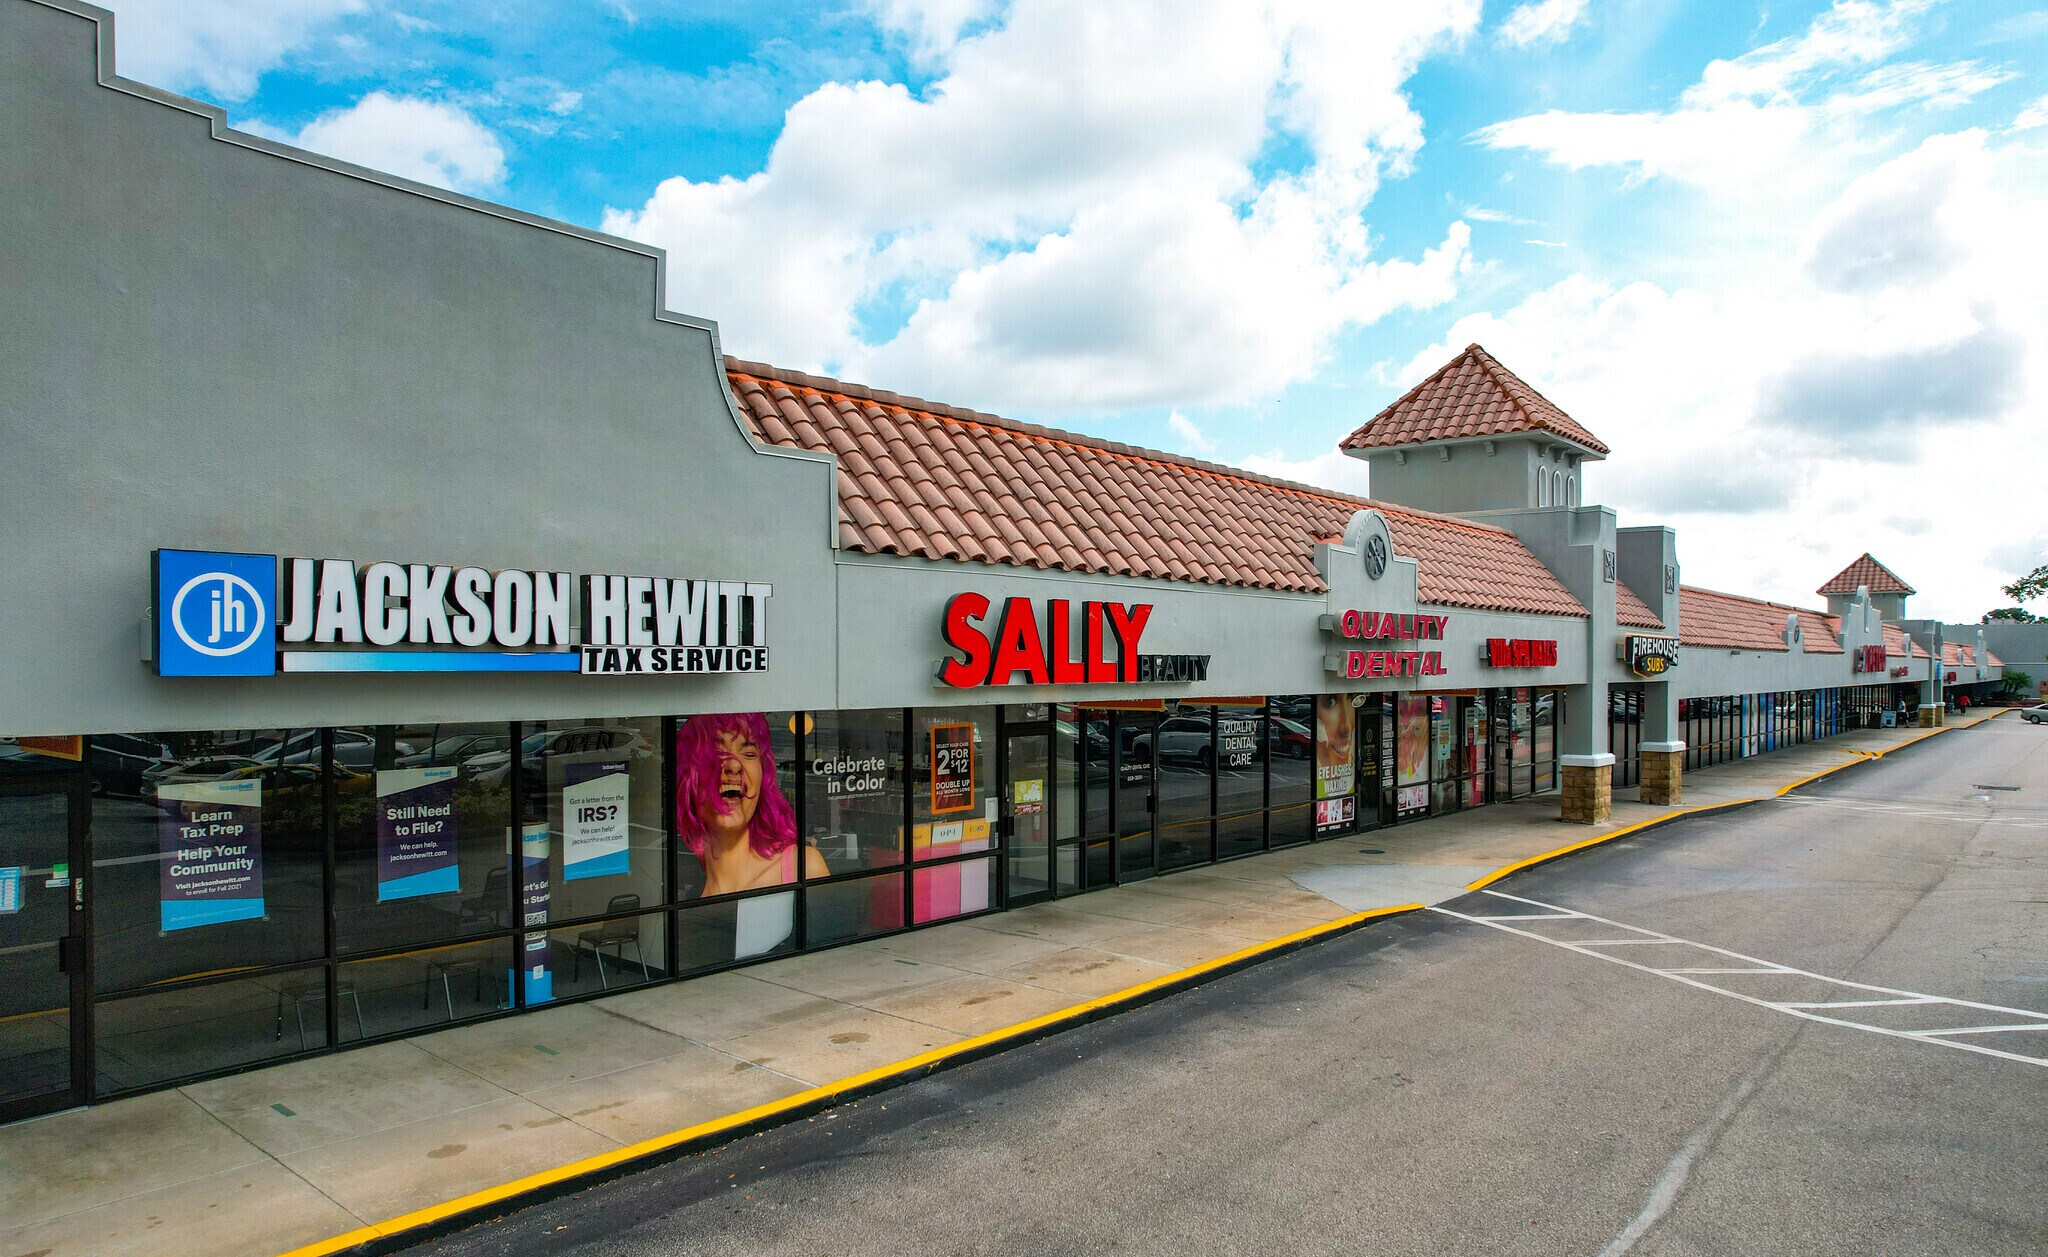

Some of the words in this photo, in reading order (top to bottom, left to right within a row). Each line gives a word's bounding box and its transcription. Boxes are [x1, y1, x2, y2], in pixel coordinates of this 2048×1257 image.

[283, 557, 571, 647] JACKSON
[587, 574, 773, 647] HEWITT
[1341, 609, 1449, 640] QUALITY
[938, 592, 1153, 688] SALLY
[1632, 636, 1679, 665] FIREHOUSE
[585, 647, 642, 672] TAX
[651, 647, 767, 672] SERVICE
[1347, 651, 1447, 678] DENTAL
[1647, 657, 1664, 672] SUBS
[1137, 655, 1211, 682] BEAUTY
[1224, 720, 1258, 734] QUALITY
[1225, 737, 1256, 750] DENTAL
[812, 755, 886, 775] Celebrate
[937, 749, 951, 775] 2
[951, 748, 969, 759] FOR
[1230, 753, 1252, 766] CARE
[1318, 766, 1330, 780] EYE
[827, 777, 841, 794] in
[845, 773, 885, 792] Color
[935, 780, 961, 790] DOUBLE
[961, 779, 971, 788] UP
[569, 797, 581, 805] Got
[585, 796, 600, 804] letter
[602, 795, 614, 803] from
[191, 810, 233, 823] Learn
[386, 806, 415, 820] Still
[417, 803, 451, 818] Need
[578, 805, 618, 823] IRS?
[180, 826, 207, 839] Tax
[209, 824, 244, 836] Prep
[395, 825, 410, 836] to
[412, 821, 444, 835] File?
[580, 827, 590, 835] We
[571, 834, 624, 847] jacksonhewitt.com
[178, 847, 212, 861] Help
[214, 844, 248, 857] Your
[390, 850, 448, 863] jacksonhewitt.com
[170, 858, 254, 877] Community
[191, 876, 251, 889] jacksonhewitt.com
[192, 887, 208, 895] enroll
[227, 883, 242, 891] 2021
